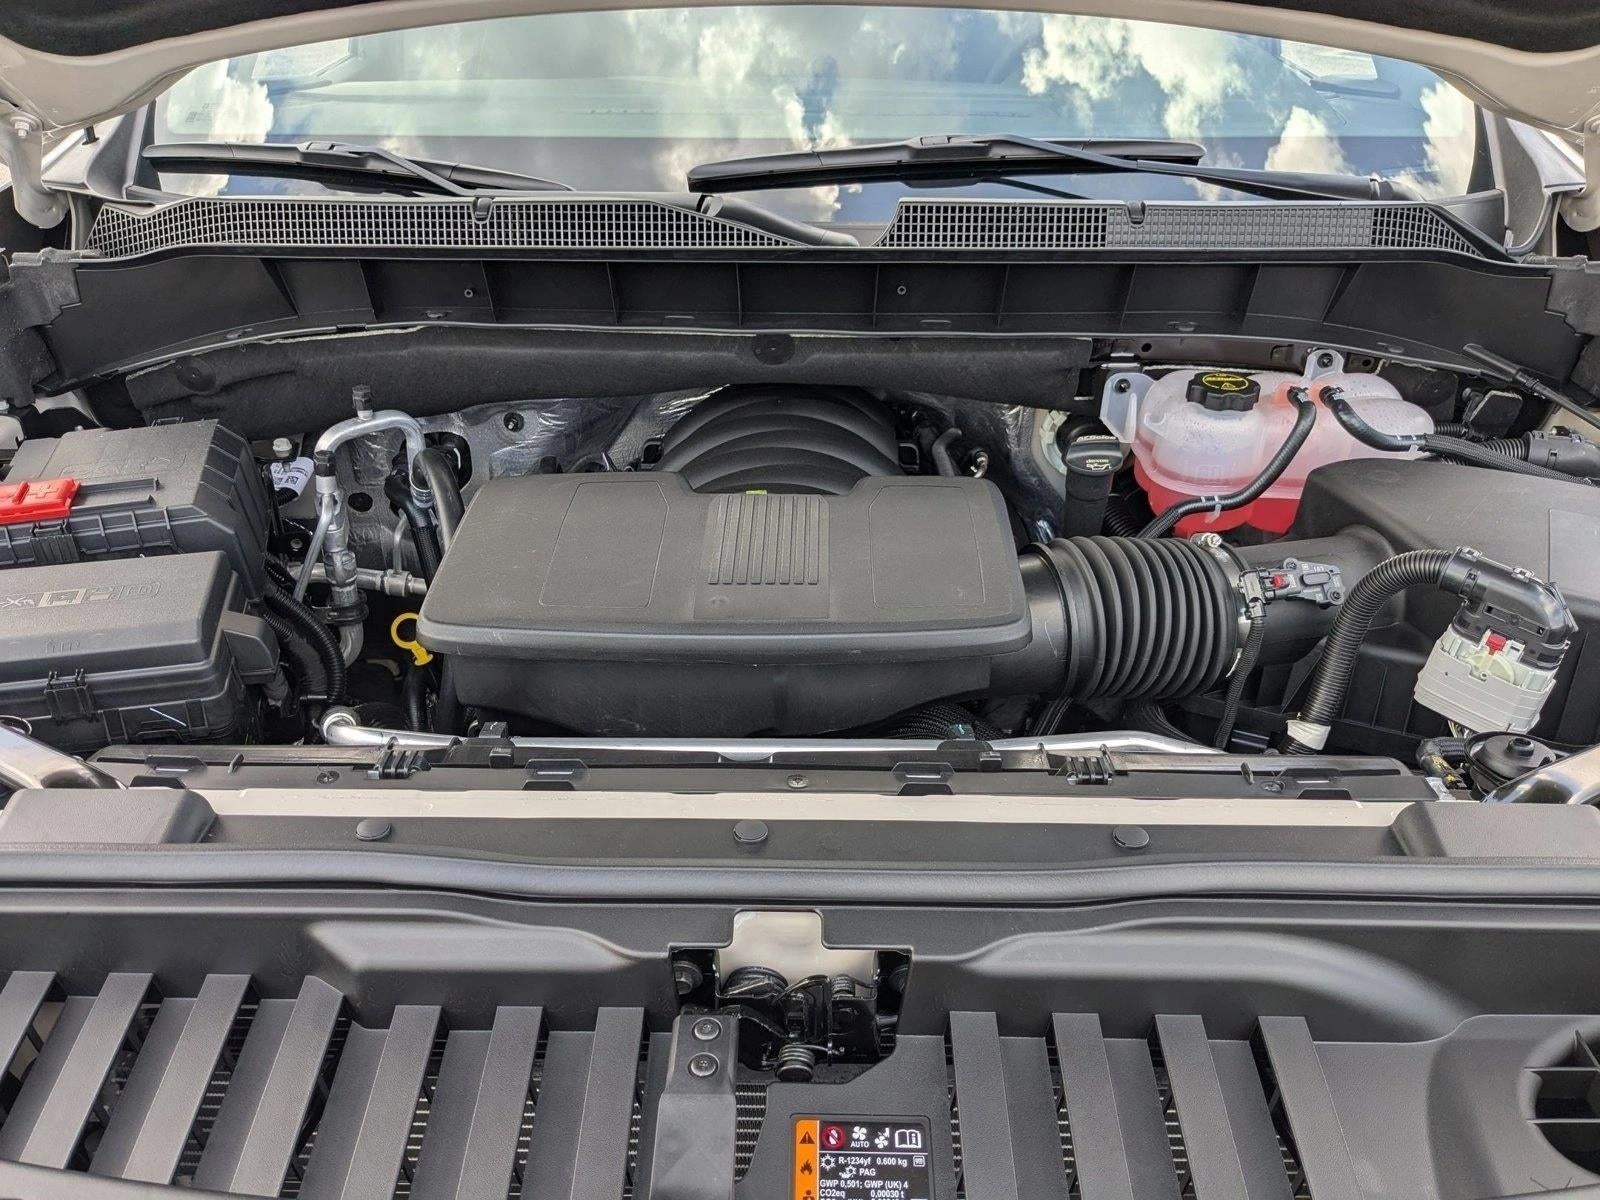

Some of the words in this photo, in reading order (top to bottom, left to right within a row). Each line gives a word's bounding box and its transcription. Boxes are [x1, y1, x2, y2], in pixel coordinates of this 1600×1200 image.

[838, 1157, 871, 1166] R-1234yf
[898, 1157, 907, 1167] kg
[859, 1168, 876, 1176] PAG
[820, 1179, 839, 1187] GWP
[864, 1180, 884, 1189] GWP
[884, 1181, 902, 1190] (UK)
[903, 1181, 909, 1189] 4
[820, 1189, 845, 1198] CO2eq
